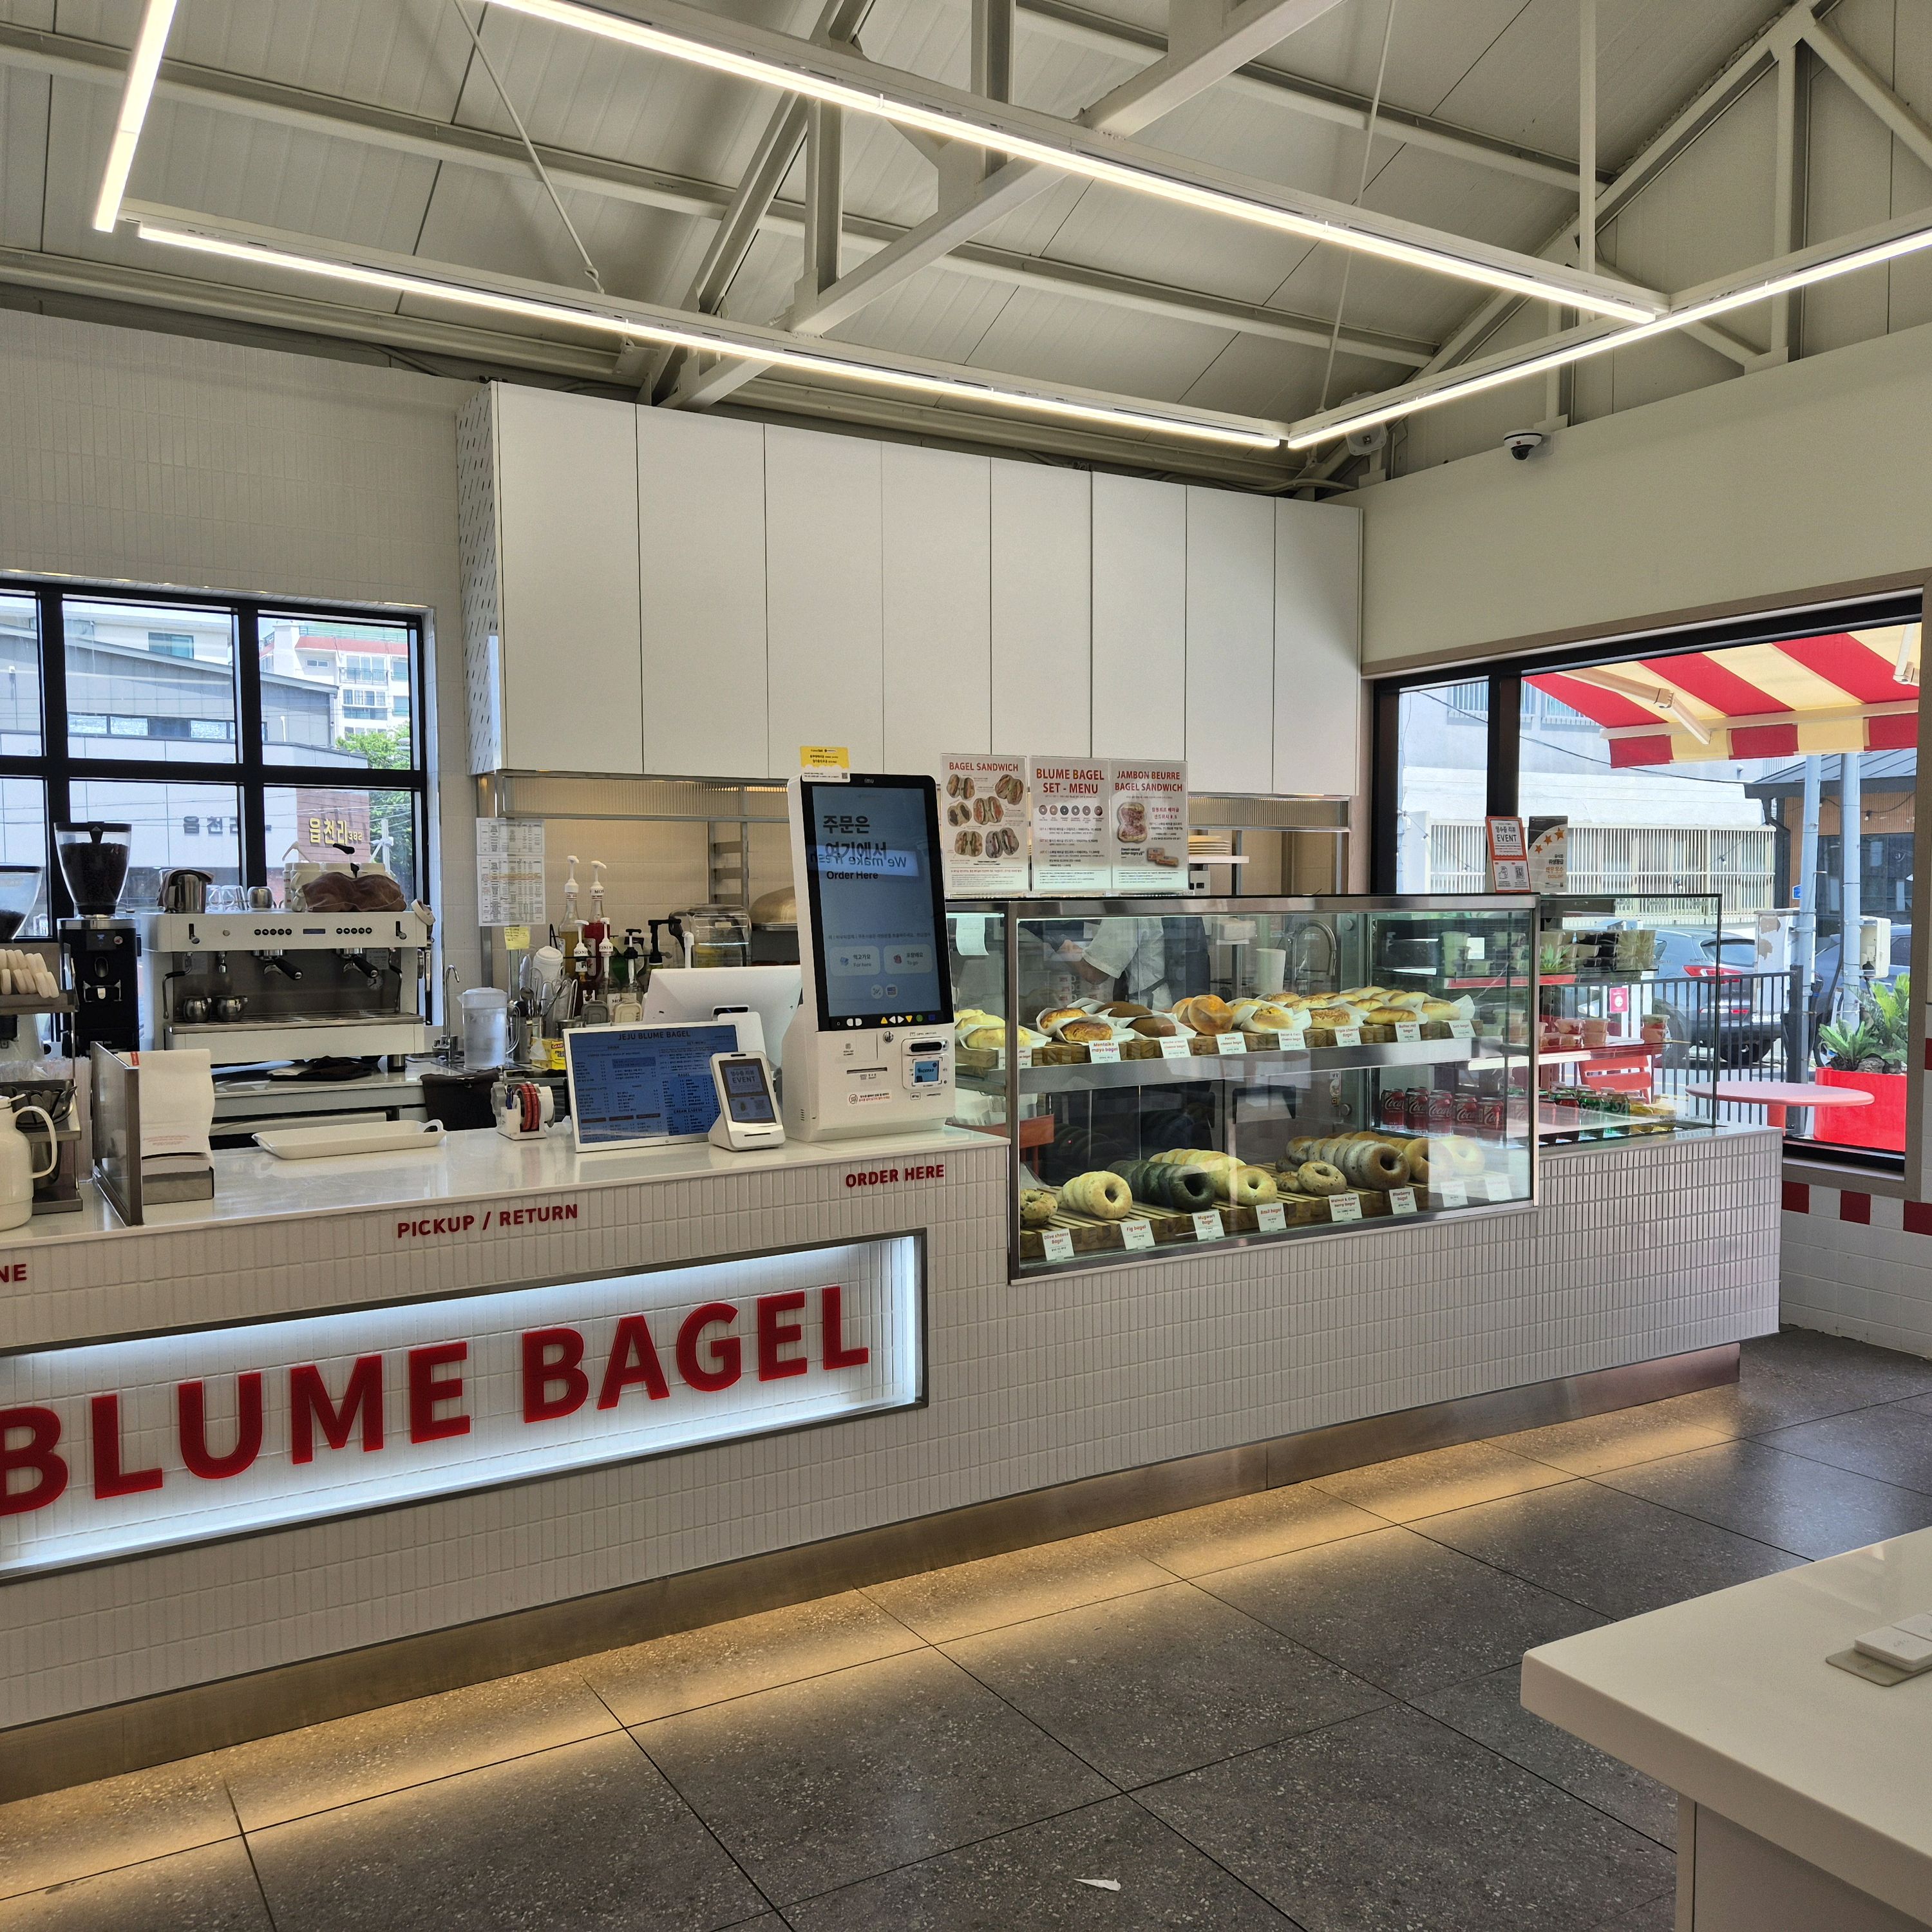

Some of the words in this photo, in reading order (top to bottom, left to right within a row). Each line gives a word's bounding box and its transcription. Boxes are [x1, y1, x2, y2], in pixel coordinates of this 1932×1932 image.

[949, 762, 974, 771] BAGEL
[977, 762, 1018, 772] SANDWICH
[1036, 768, 1070, 780] BLUME
[1073, 769, 1104, 781] BAGEL
[1116, 770, 1150, 780] JAMBON
[1151, 772, 1180, 781] BEURRE
[1043, 782, 1061, 793] SET
[1069, 783, 1099, 794] MENU
[1115, 782, 1139, 791] BAGEL
[1141, 783, 1182, 792] SANDWICH
[823, 815, 870, 834] 주문은
[309, 817, 347, 845] 읍천리
[348, 830, 363, 841] 382
[1497, 834, 1517, 842] EVENT
[826, 871, 854, 880] Order
[856, 871, 878, 880] Here
[618, 1032, 636, 1041] JEJU
[638, 1032, 664, 1040] BLUME
[666, 1030, 691, 1039] BAGEL
[845, 1169, 899, 1188] ORDER
[905, 1164, 944, 1181] HERE
[397, 1215, 475, 1238] PICKUP
[482, 1211, 491, 1230] /
[499, 1204, 578, 1227] RETURN
[0, 1341, 471, 1517] BLUME
[522, 1285, 869, 1424] BAGEL
